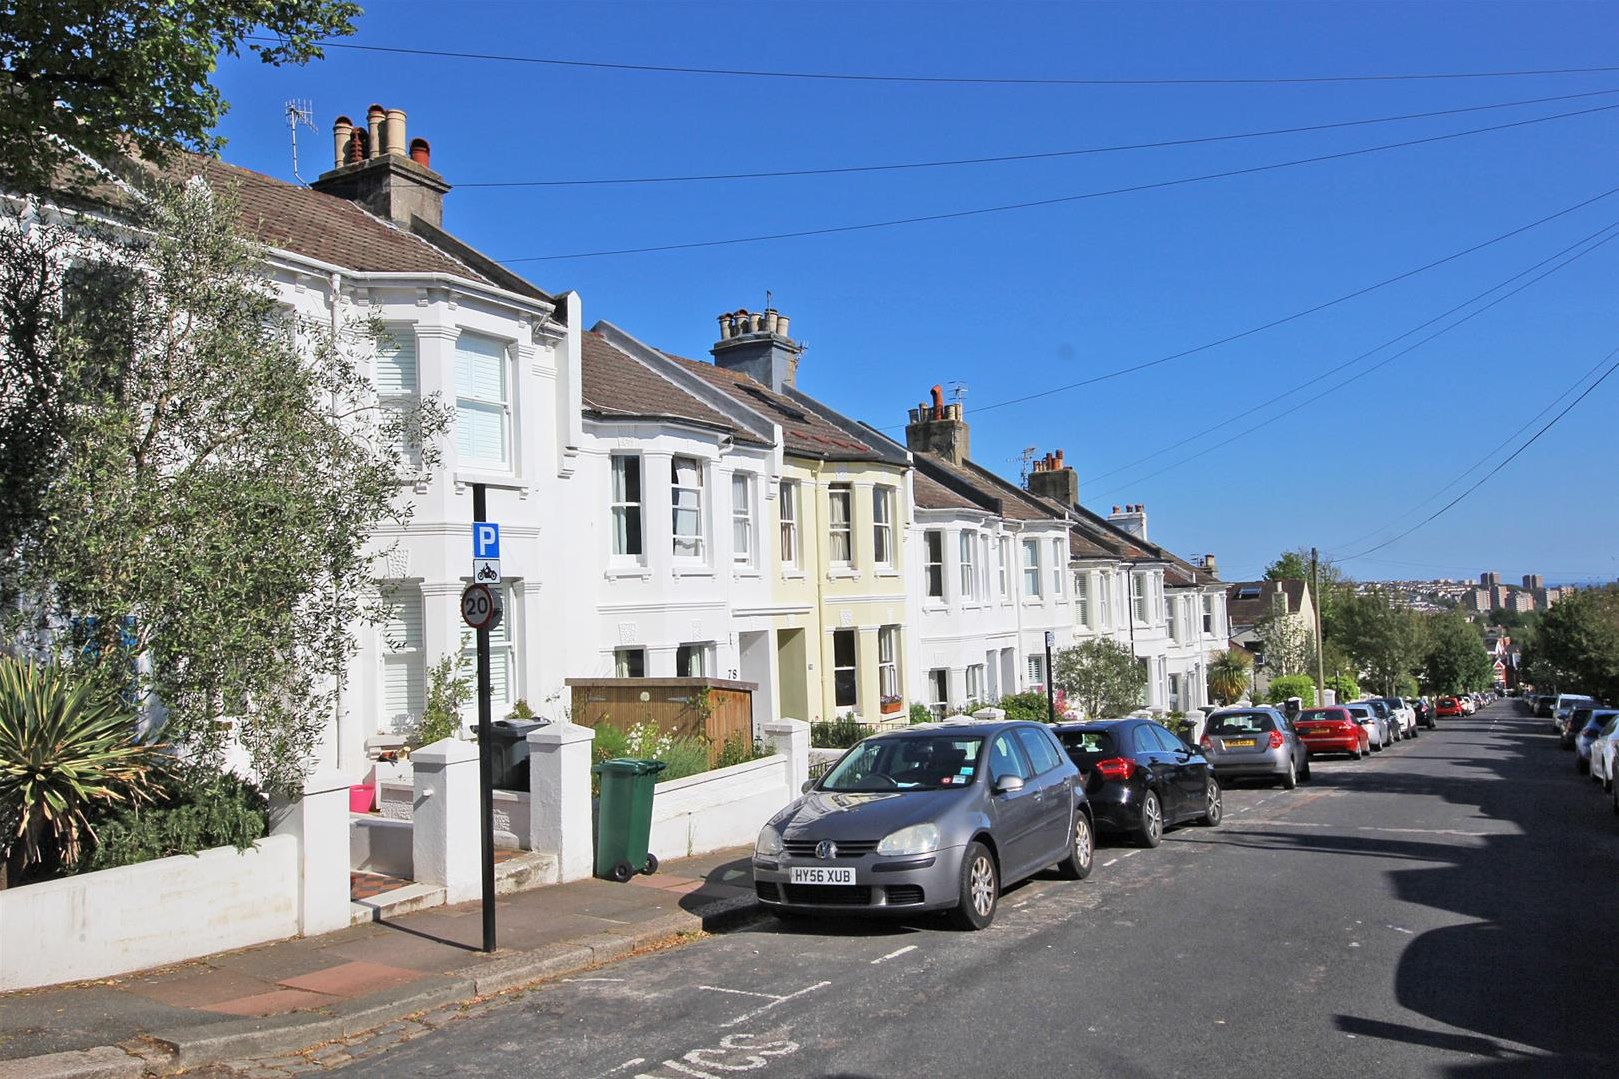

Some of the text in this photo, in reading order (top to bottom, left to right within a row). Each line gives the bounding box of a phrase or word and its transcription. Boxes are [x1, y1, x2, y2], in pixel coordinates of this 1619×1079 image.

[479, 526, 496, 556] P
[466, 597, 488, 616] 20
[795, 869, 850, 883] HY56 XUB
